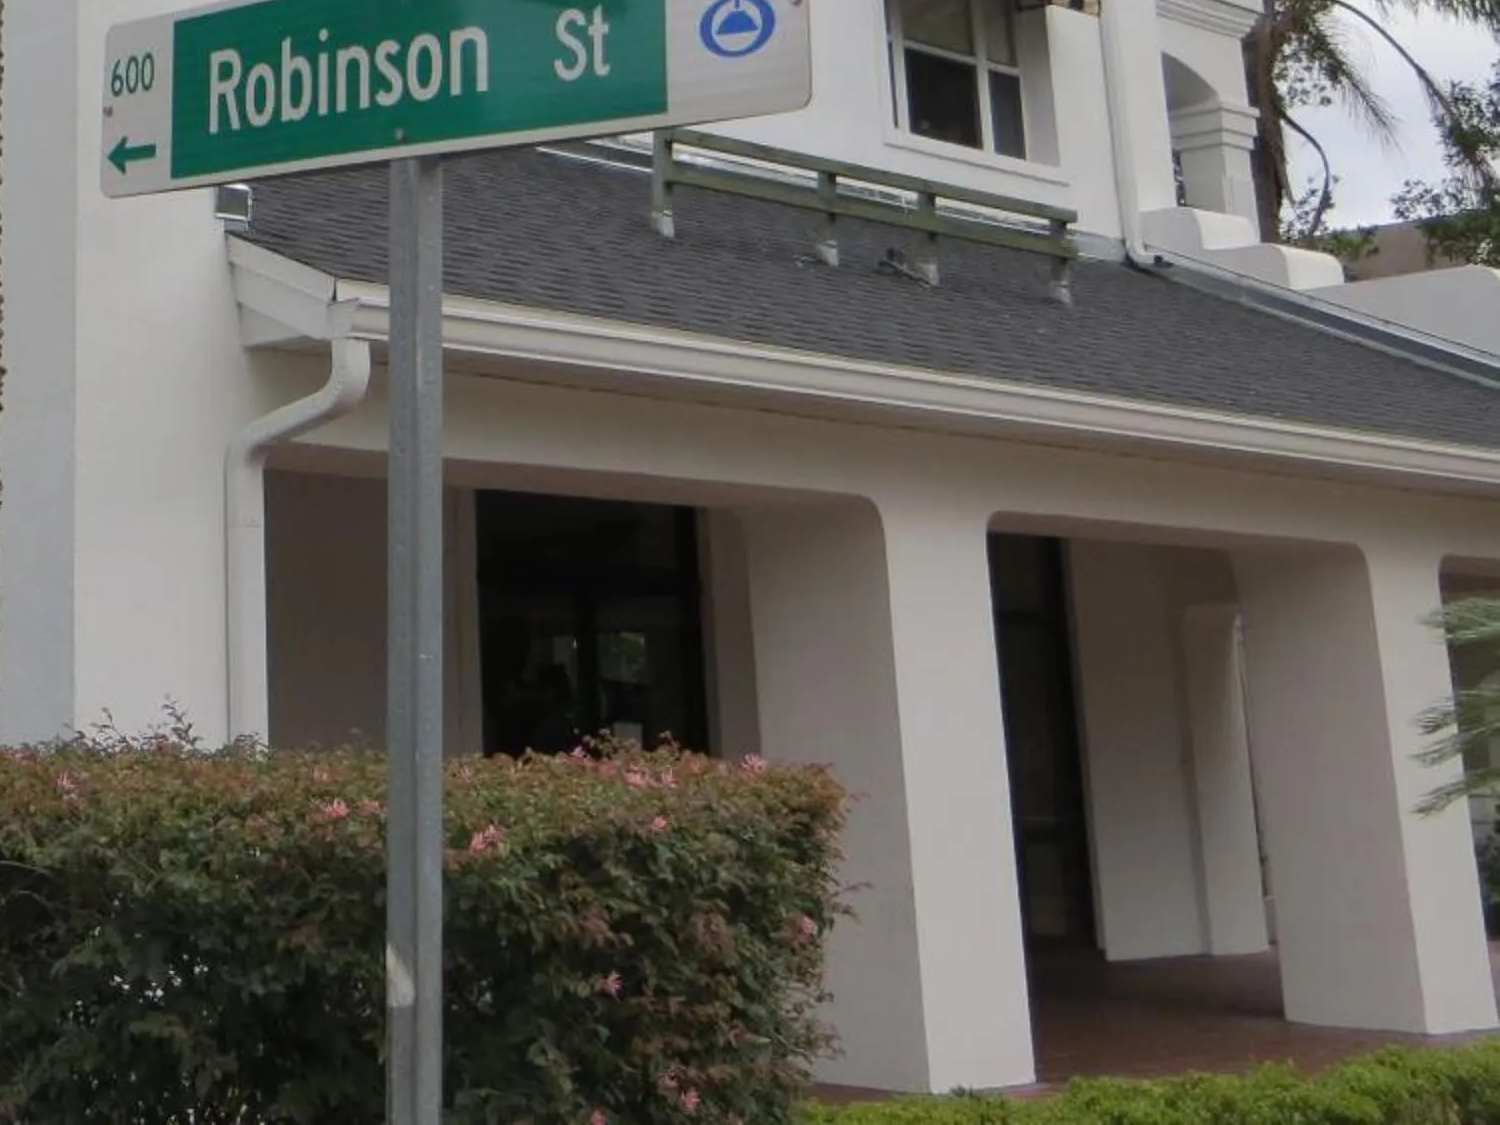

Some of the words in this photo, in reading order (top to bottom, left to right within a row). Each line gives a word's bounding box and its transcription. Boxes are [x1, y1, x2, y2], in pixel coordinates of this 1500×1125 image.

[111, 52, 154, 97] 600
[208, 24, 488, 135] Robinson
[553, 5, 609, 81] St
